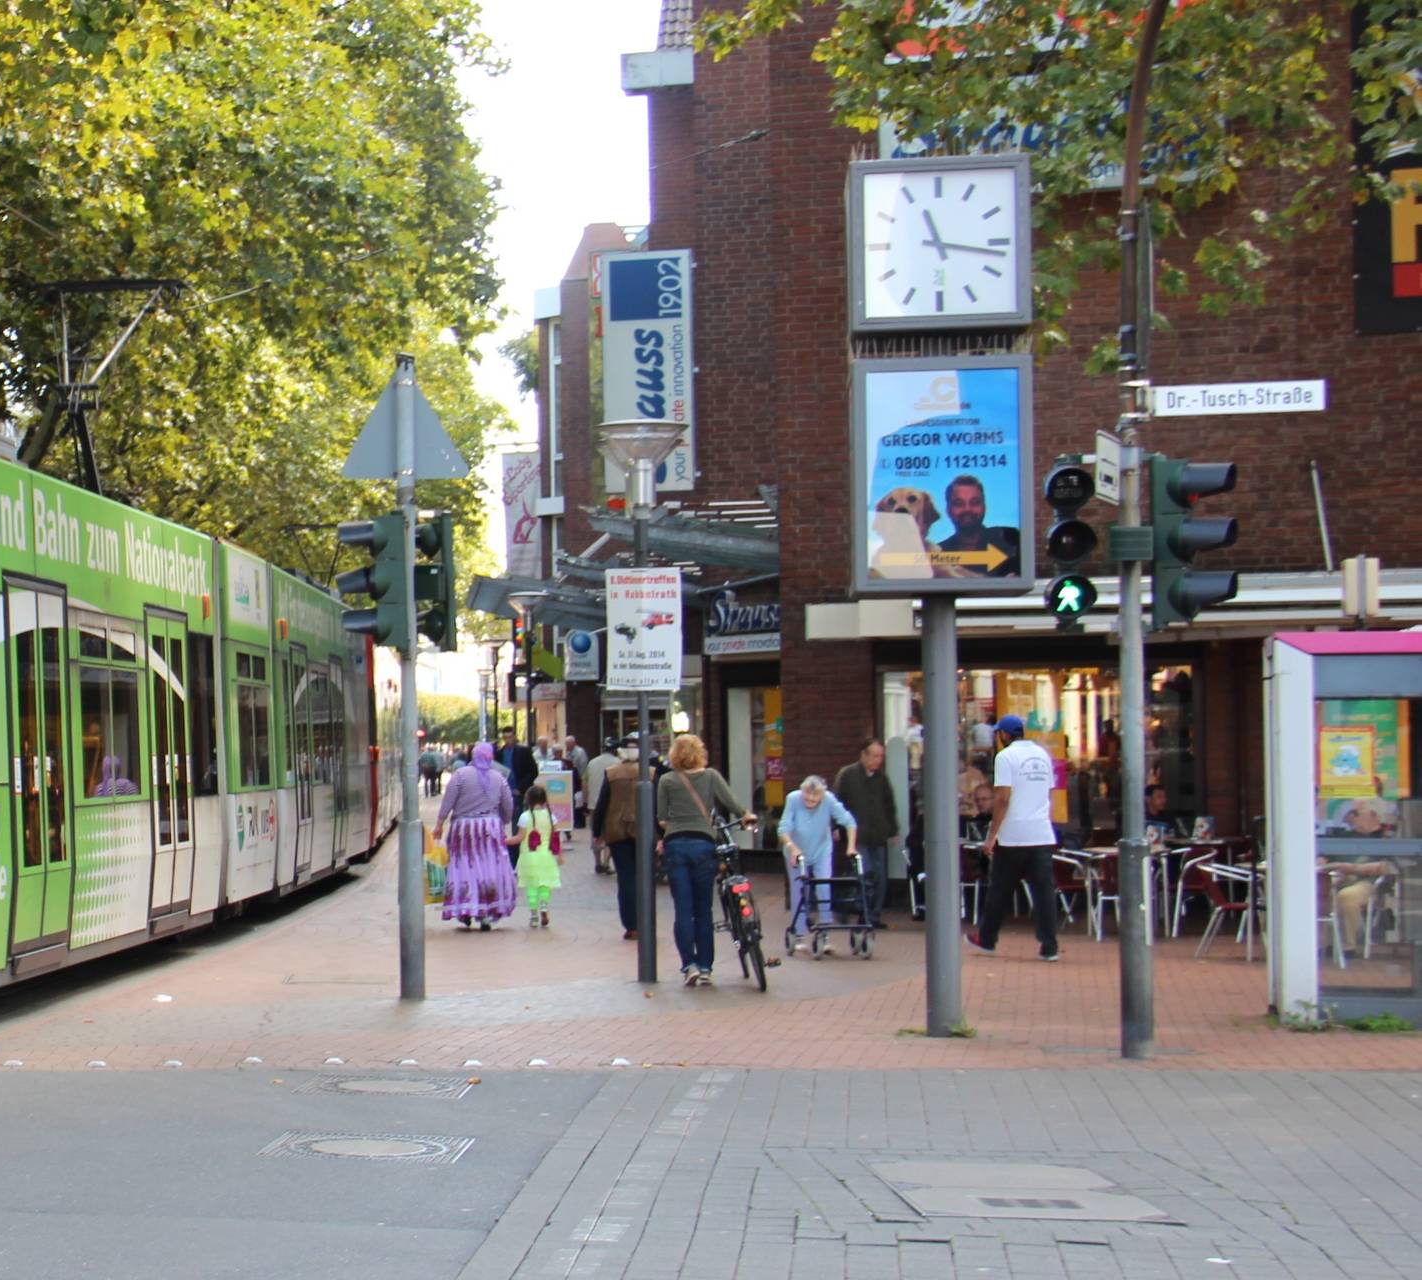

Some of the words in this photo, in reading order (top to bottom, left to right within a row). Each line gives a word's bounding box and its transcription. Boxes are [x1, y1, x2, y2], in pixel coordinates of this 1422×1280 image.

[656, 258, 683, 319] 1902
[669, 324, 684, 399] innovation
[1166, 386, 1314, 409] Dr.-Tusch-Straße
[881, 432, 941, 447] GREGOR
[945, 430, 1005, 445] WORMS
[674, 451, 688, 482] your
[894, 456, 931, 470] 0800
[944, 454, 1007, 469] 1121314
[33, 487, 80, 565] Bahn
[85, 521, 120, 576] zum
[930, 554, 961, 563] Meter
